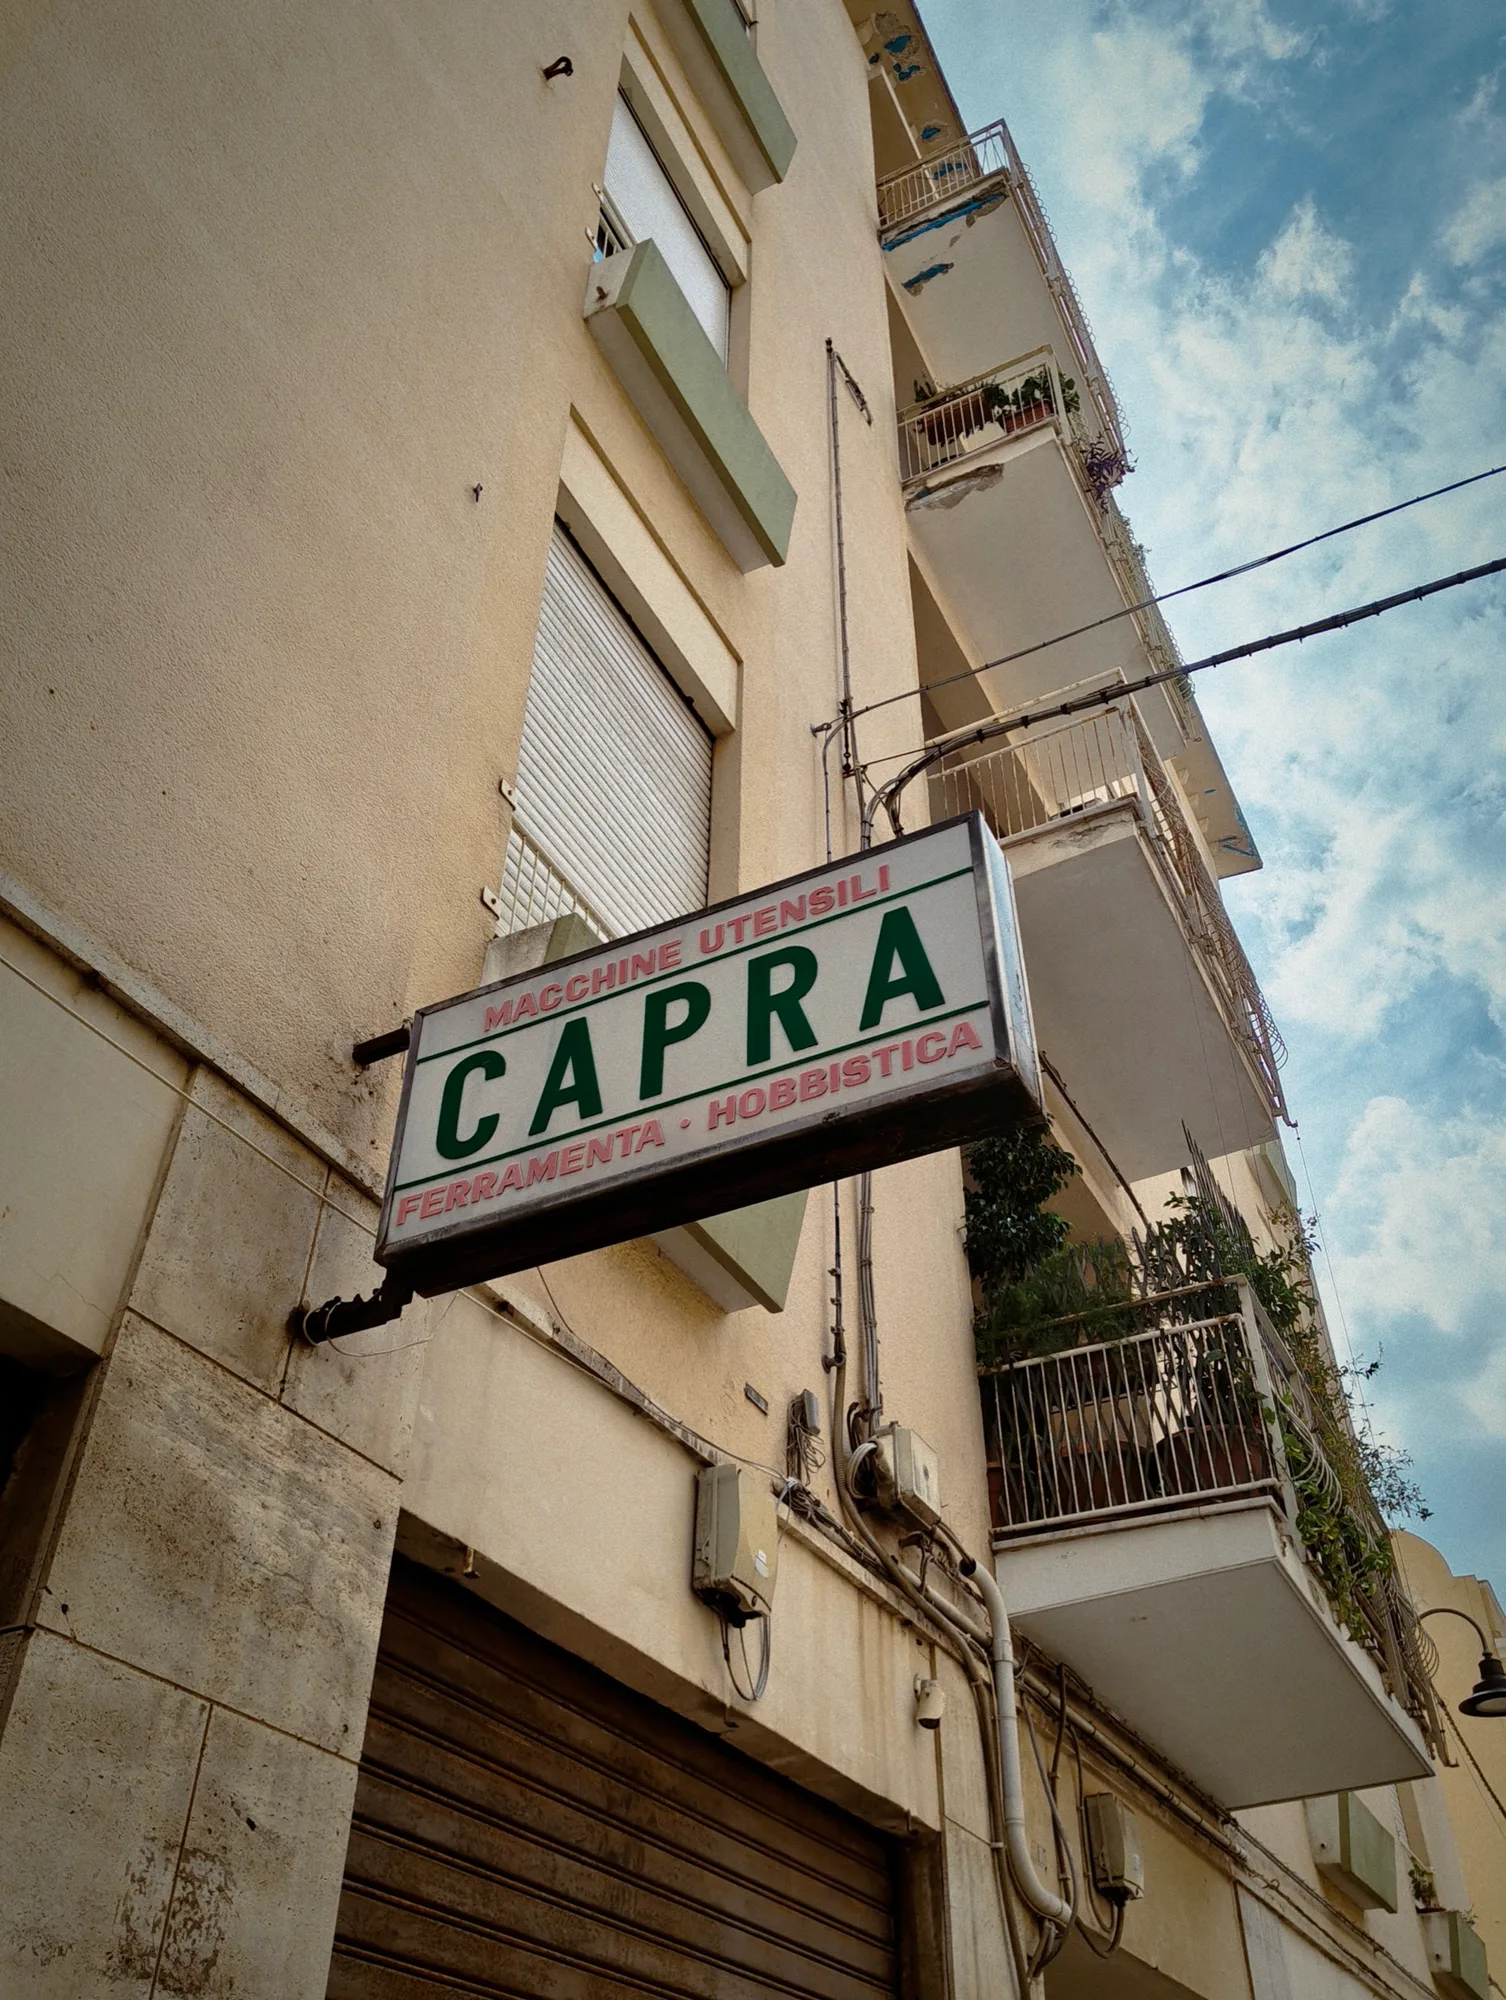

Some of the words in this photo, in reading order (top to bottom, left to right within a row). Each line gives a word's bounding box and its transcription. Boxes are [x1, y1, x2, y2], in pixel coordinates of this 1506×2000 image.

[435, 905, 946, 1160] CAPRA
[484, 940, 682, 1031] MACCHINE
[699, 865, 890, 954] UTENSILI
[396, 1119, 664, 1226] FERRAMENTA
[708, 1021, 982, 1130] HOBBISTICA
